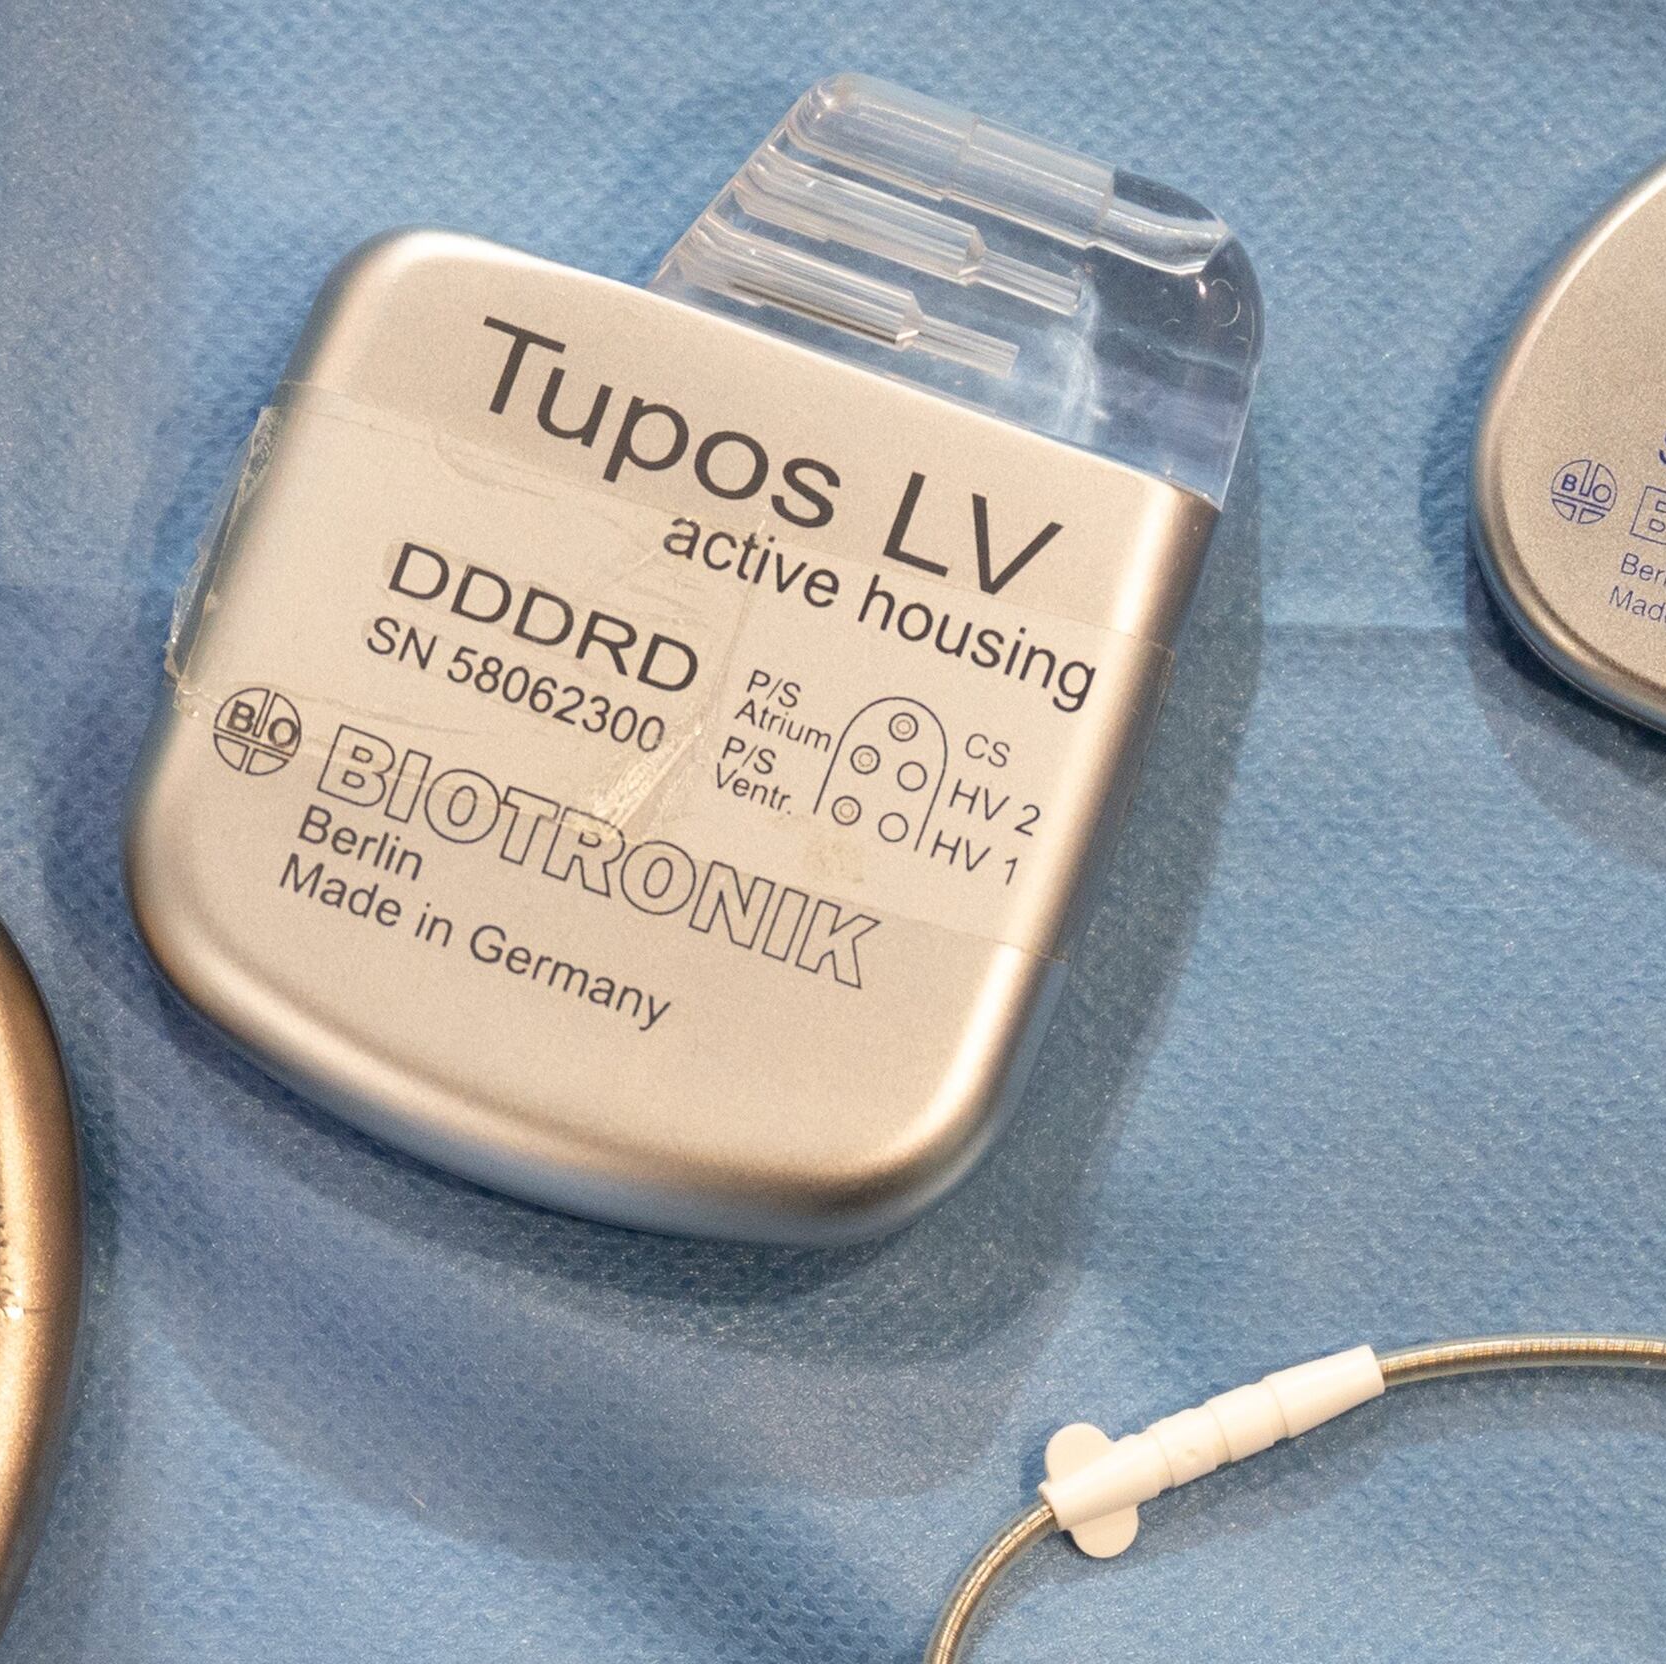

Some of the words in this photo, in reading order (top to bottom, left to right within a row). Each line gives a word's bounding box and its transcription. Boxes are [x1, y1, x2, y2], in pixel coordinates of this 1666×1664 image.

[483, 317, 840, 531] Tupos
[883, 473, 1064, 597] LV
[389, 543, 699, 693] DDDRD
[663, 517, 839, 608] active
[858, 575, 1097, 712] housing
[366, 617, 436, 672] SN
[447, 645, 666, 753] 58062300
[747, 670, 800, 709] P/S
[721, 736, 777, 776] P/S
[734, 699, 833, 751] Atrium
[964, 734, 1010, 768] CS
[715, 767, 795, 815] Ventr.
[949, 778, 1010, 822] HV
[1014, 805, 1042, 837] 2
[299, 806, 422, 881] Berlin
[316, 725, 881, 987] BIOTRONIK
[930, 831, 992, 873] HV
[1003, 856, 1020, 885] 1
[280, 854, 403, 926] Made
[418, 903, 455, 946] in
[470, 924, 671, 1032] Germany
